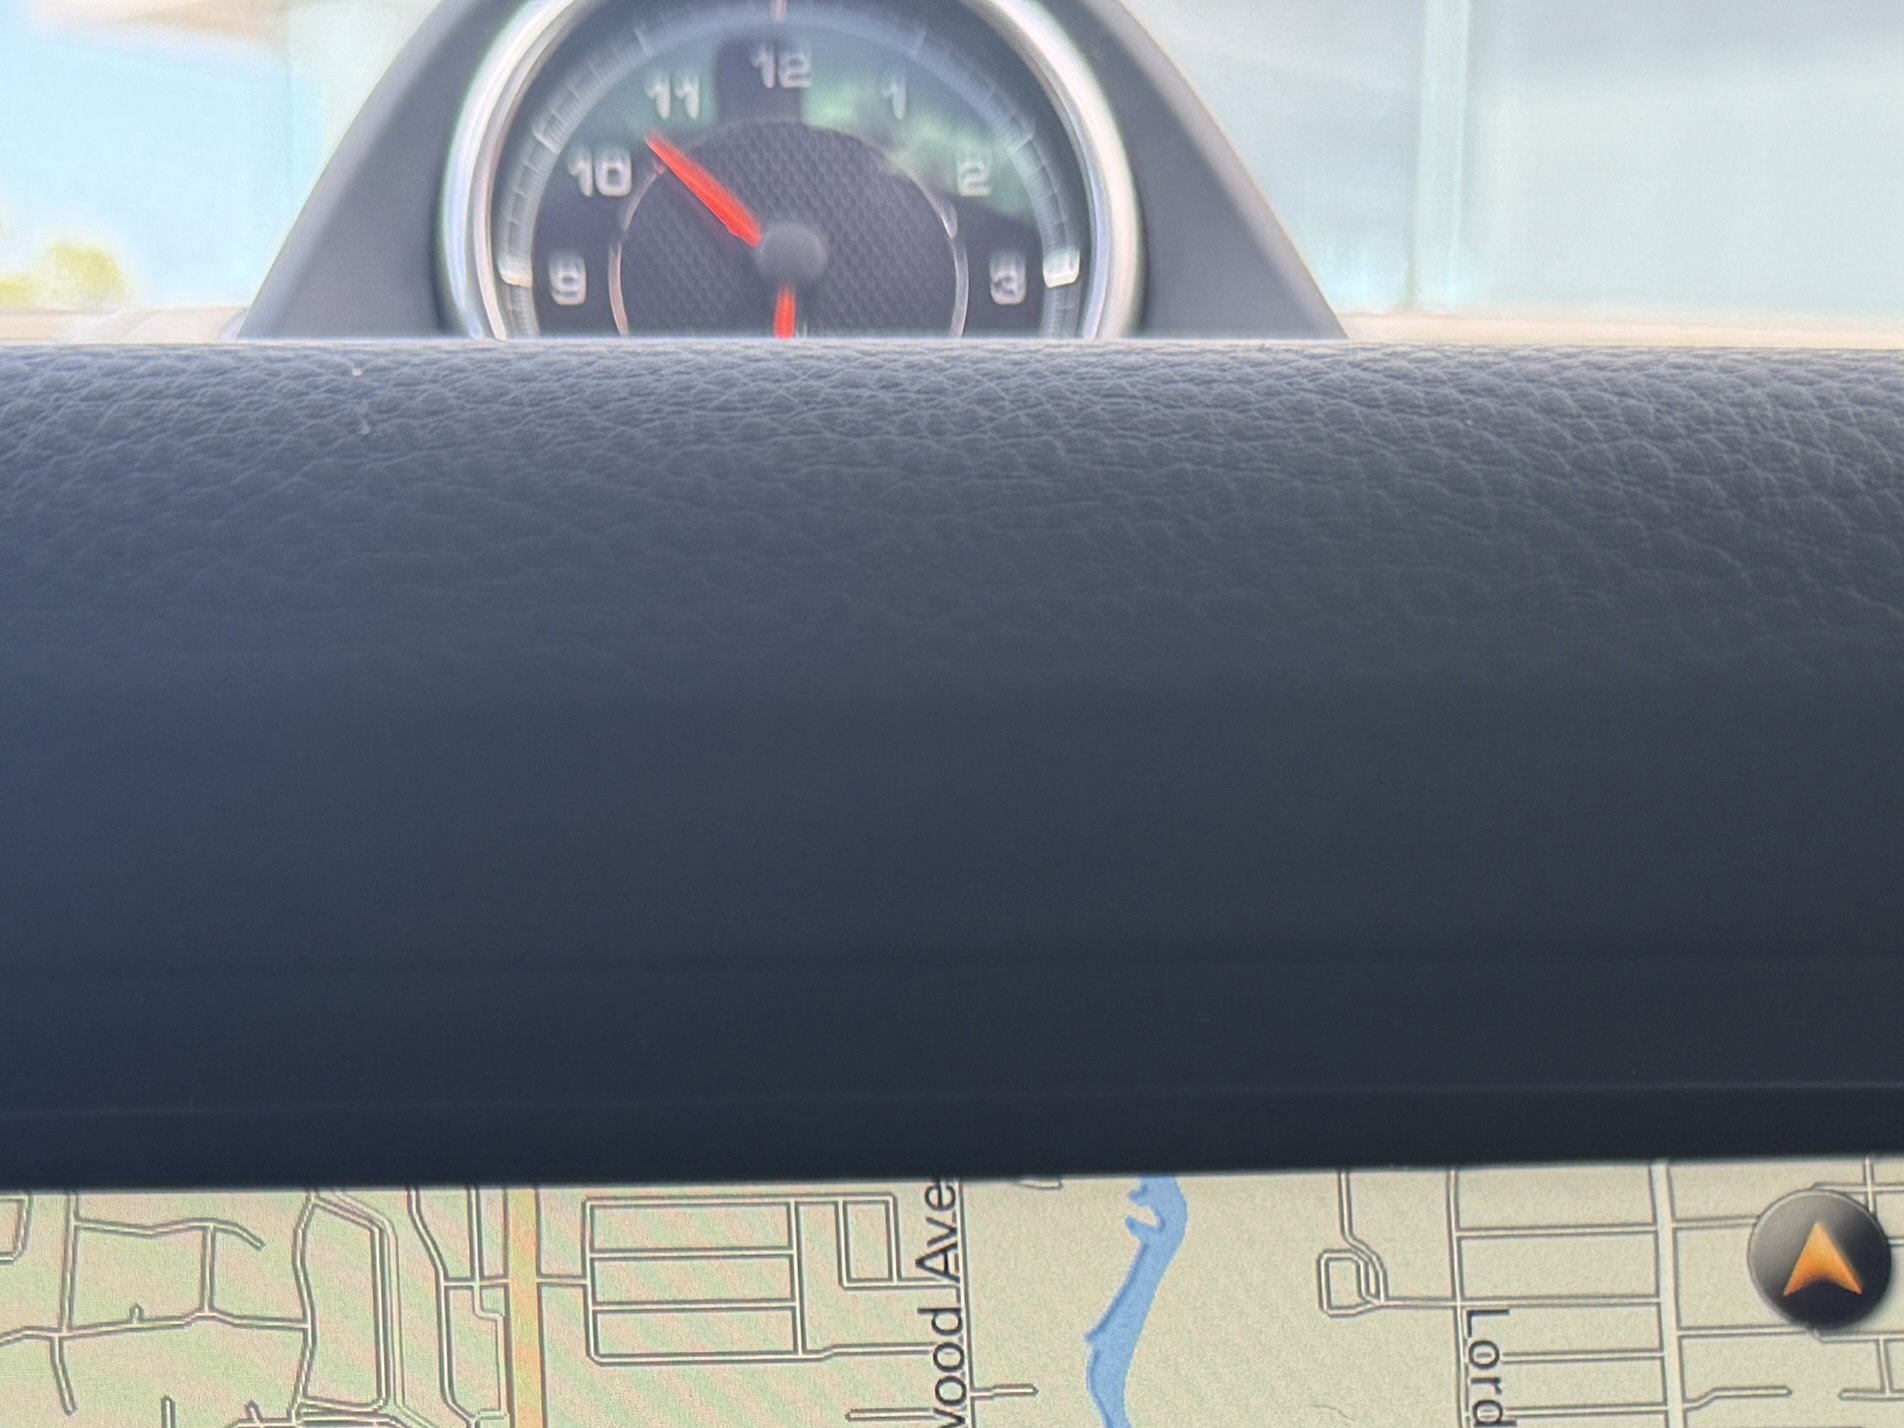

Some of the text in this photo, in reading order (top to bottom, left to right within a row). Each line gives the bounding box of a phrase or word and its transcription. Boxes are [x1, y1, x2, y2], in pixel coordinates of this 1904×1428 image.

[751, 50, 812, 89] 12
[645, 75, 702, 121] 11
[883, 76, 908, 121] 1
[570, 149, 633, 198] 10
[957, 157, 991, 198] 2
[549, 256, 588, 306] 9
[989, 256, 1027, 306] 3
[915, 1179, 961, 1284] Ave
